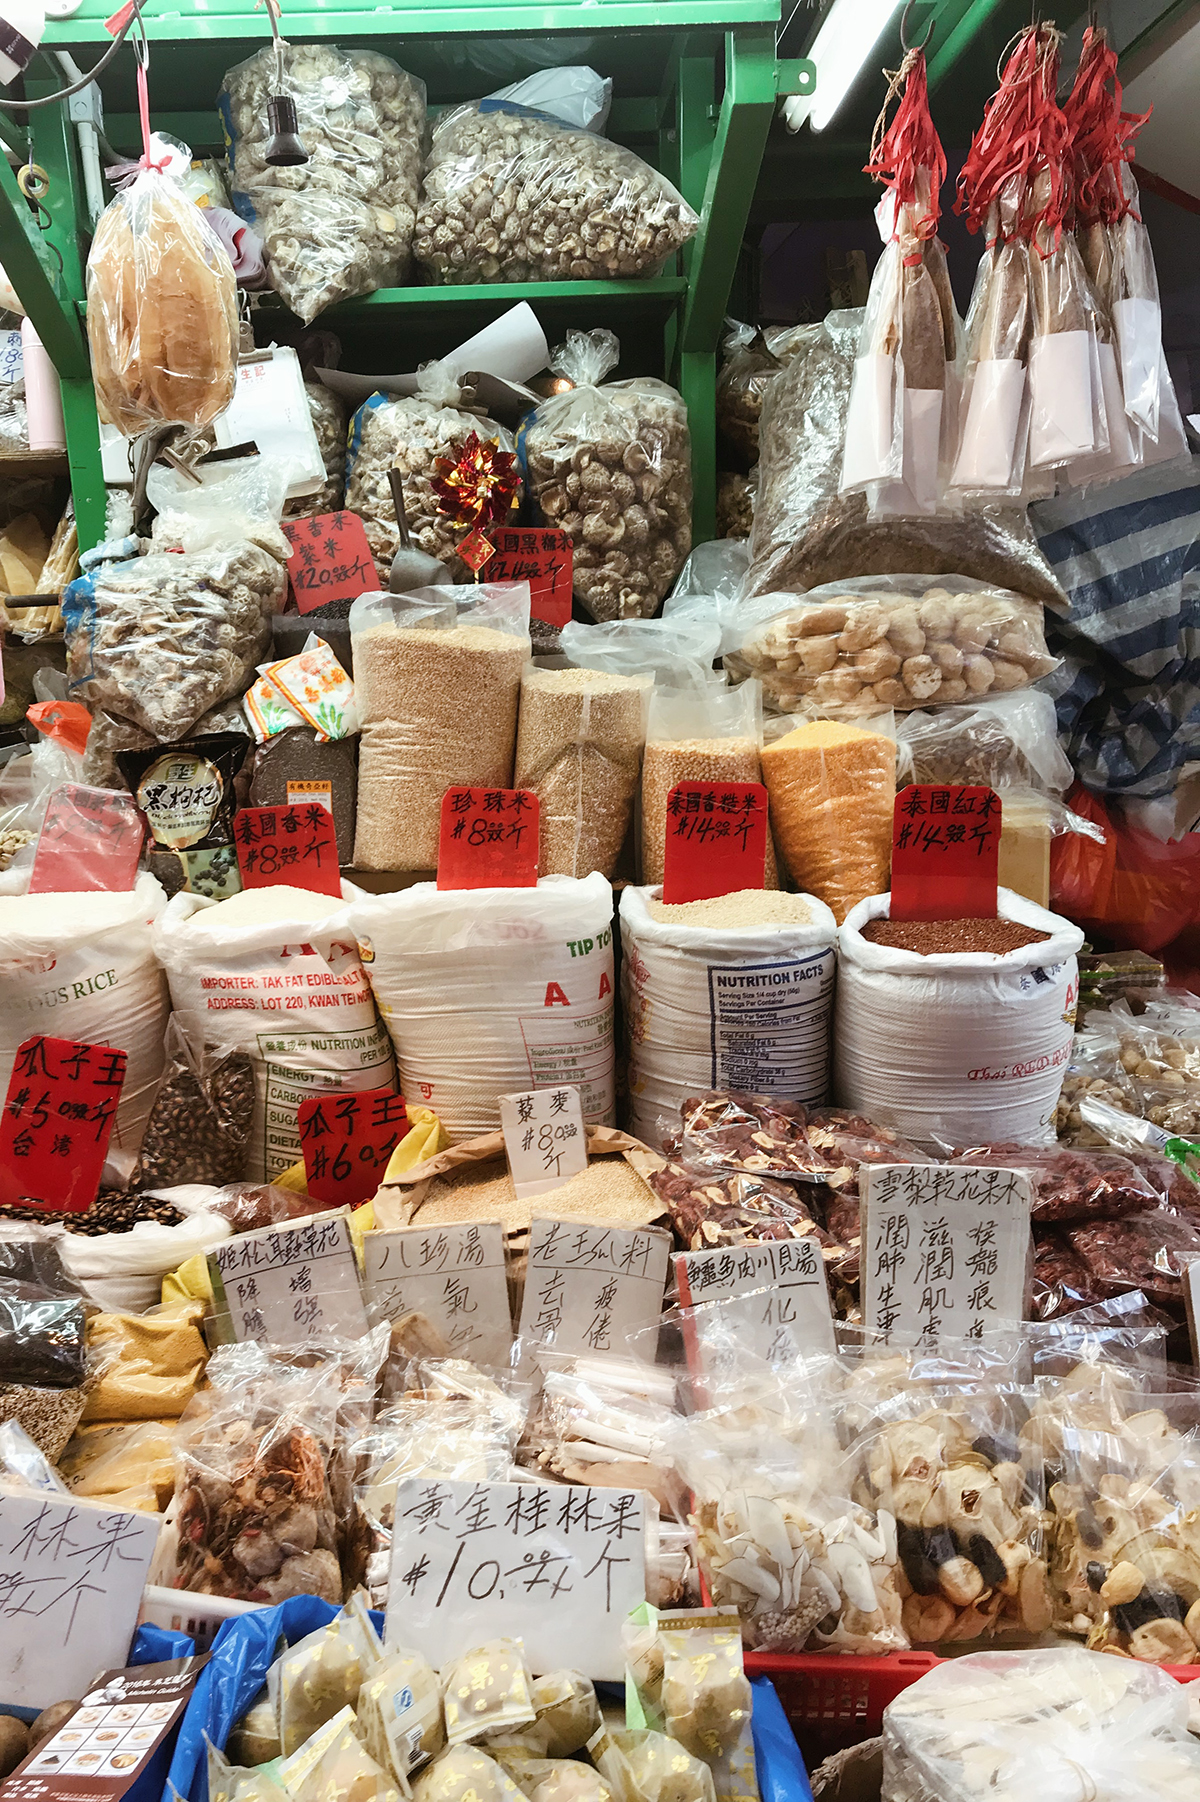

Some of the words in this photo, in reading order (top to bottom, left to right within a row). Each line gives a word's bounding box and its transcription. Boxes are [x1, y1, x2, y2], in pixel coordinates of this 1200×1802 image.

[144, 782, 218, 812] 黑枸杞
[450, 789, 533, 814] 珍珠米
[667, 788, 763, 817] 泰國香糙米
[901, 788, 1002, 818] 泰國紅米
[236, 805, 328, 845] 泰國香米
[566, 938, 594, 958] TIP
[72, 969, 119, 999] RICE
[201, 977, 258, 990] IMPORTER:
[261, 976, 283, 989] TAK
[285, 975, 304, 988] FAT
[544, 981, 571, 1007] A
[598, 972, 611, 1000] A
[717, 971, 790, 988] NUTRITION
[793, 964, 824, 982] FACTS
[207, 997, 259, 1010] ADDRESS:
[261, 997, 282, 1011] LOT
[308, 993, 340, 1008] KWAN
[311, 1037, 365, 1050] NUTRITION
[15, 1037, 128, 1086] 瓜子王
[418, 1082, 434, 1099] 可
[301, 1094, 407, 1141] 瓜子王
[543, 1147, 565, 1177] 斤
[378, 1226, 485, 1272] 八珍湯
[686, 1242, 818, 1292] 鱷魚肉川貝湯
[403, 1483, 641, 1539] 黃金桂林果
[0, 1497, 144, 1572] 林果
